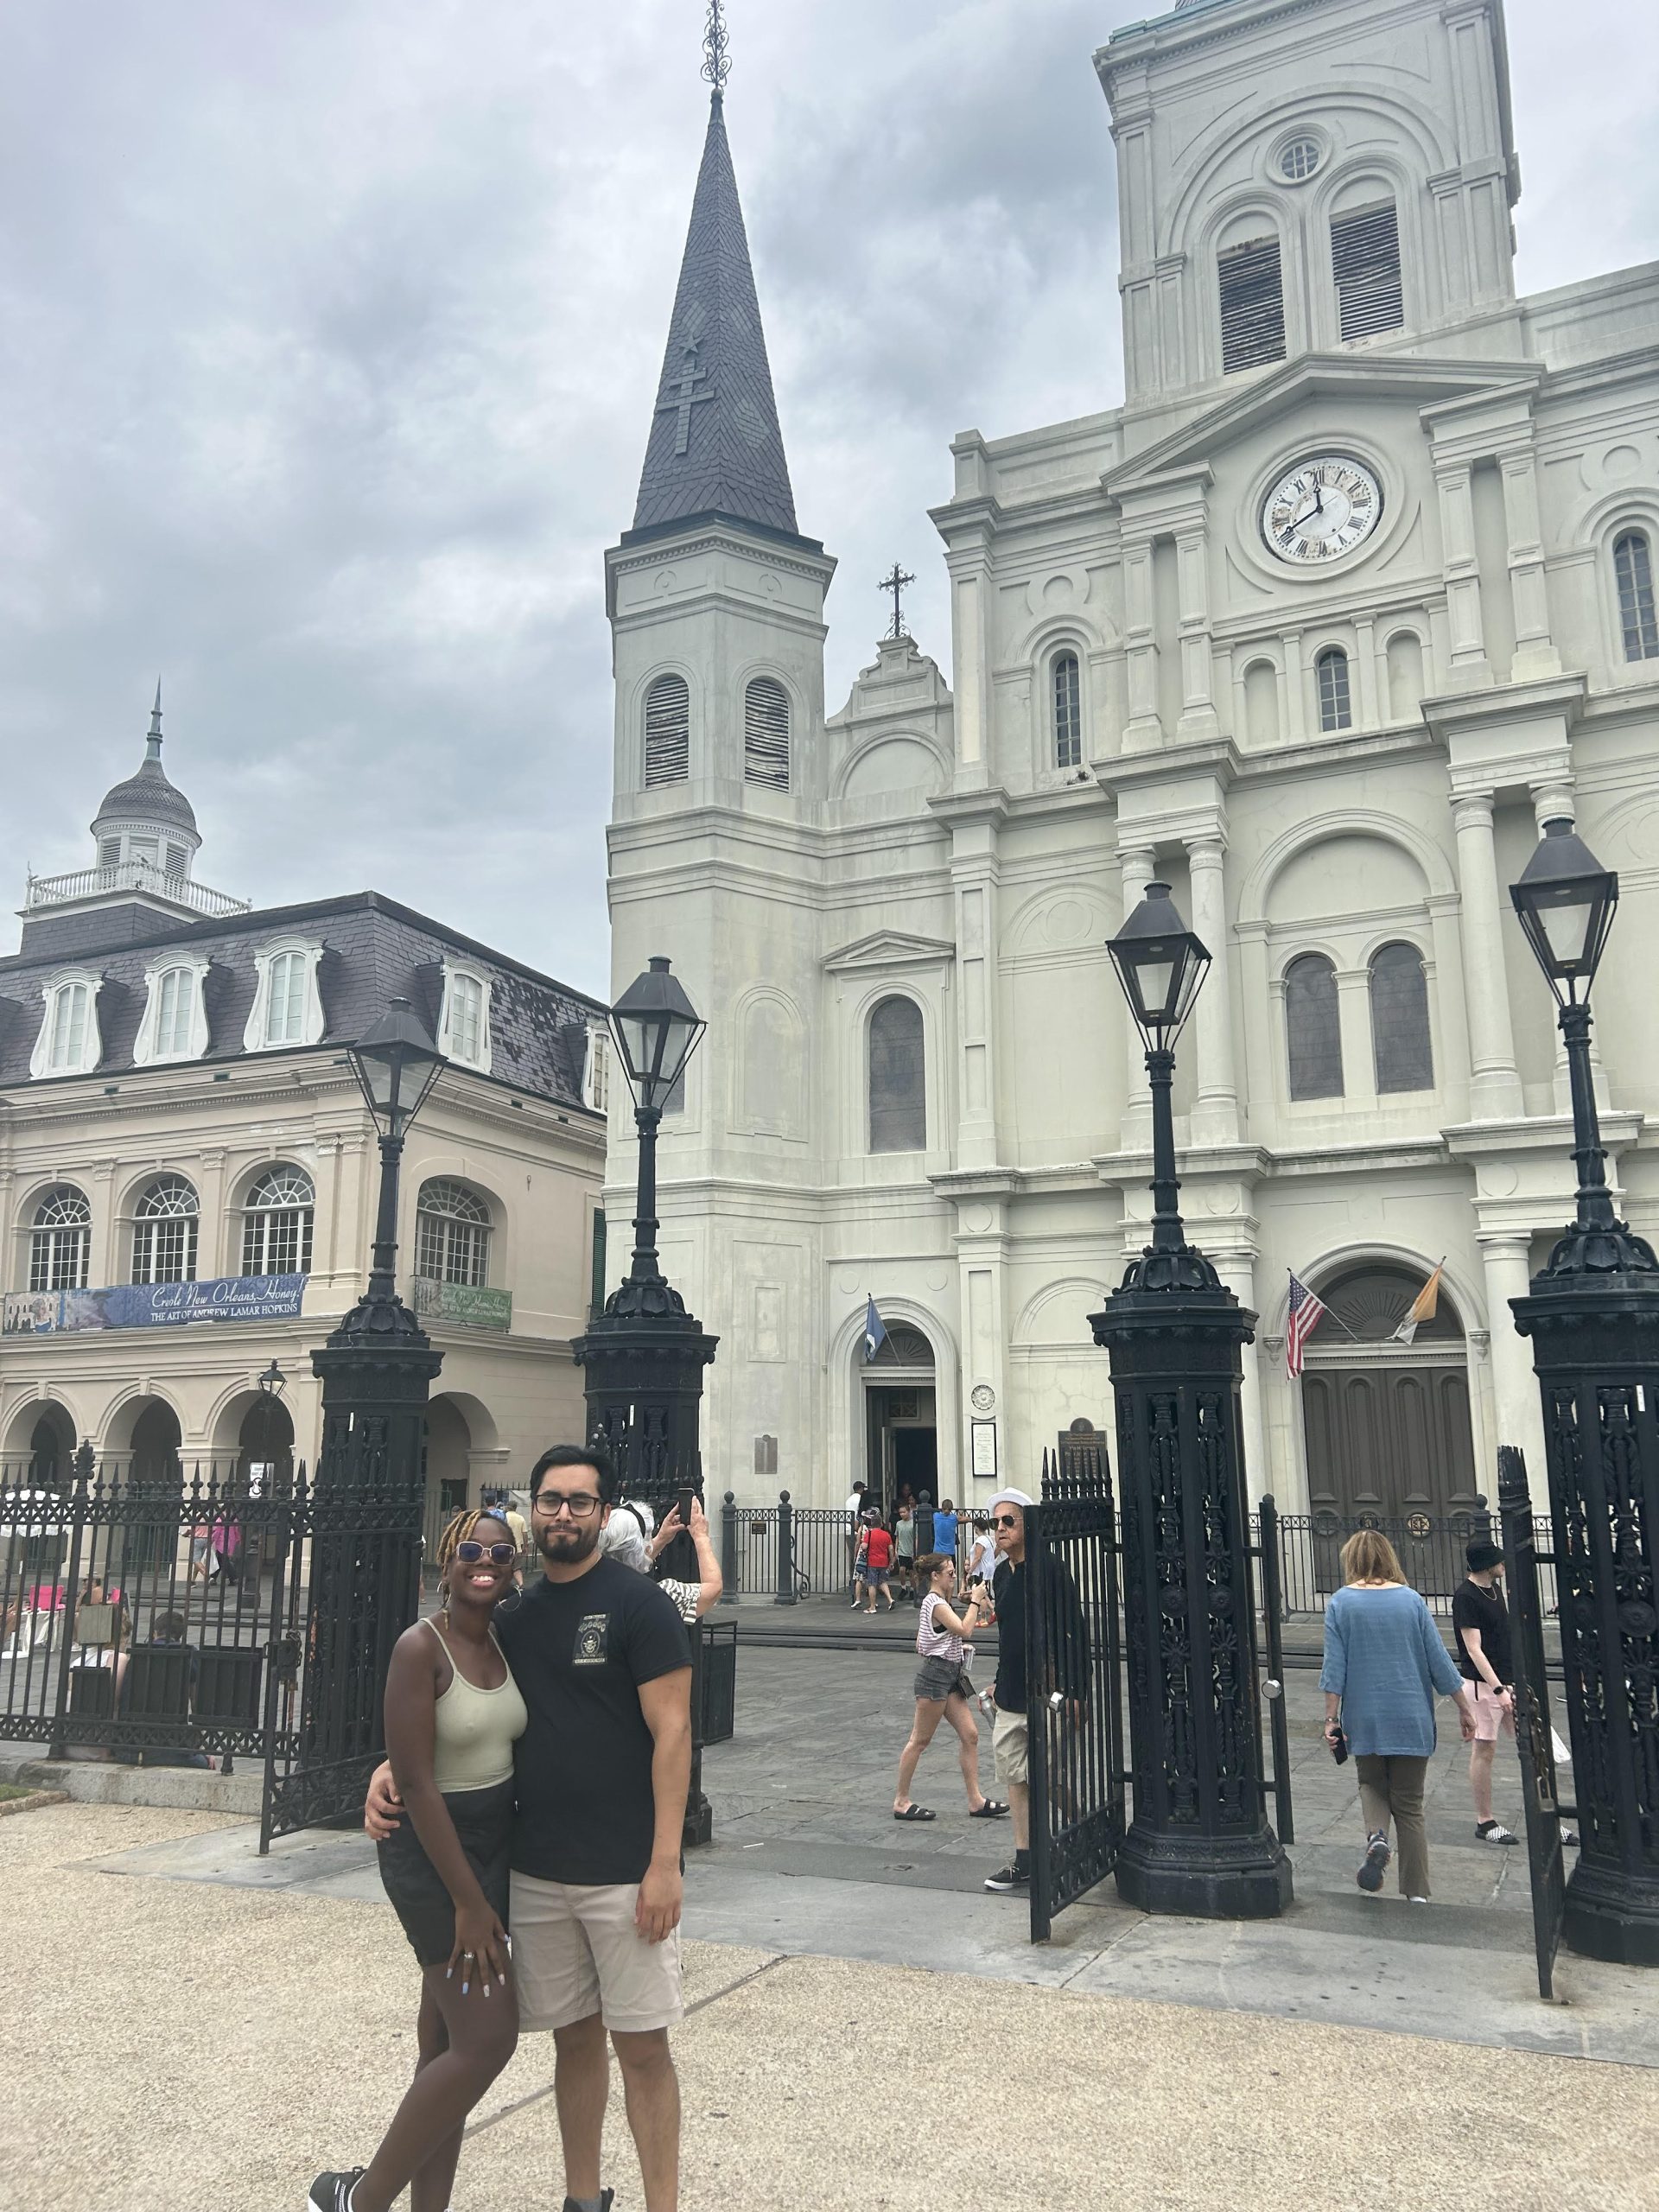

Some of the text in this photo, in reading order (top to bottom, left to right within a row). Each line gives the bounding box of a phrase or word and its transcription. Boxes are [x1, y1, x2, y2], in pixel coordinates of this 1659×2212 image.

[1293, 479, 1306, 494] XI
[1347, 480, 1362, 494] II
[1279, 497, 1294, 507] X
[1352, 498, 1369, 509] III
[152, 1277, 304, 1307] Creole New Orleans, Honey!
[150, 1302, 298, 1322] THE ART OF ANDREW LAMAR HOPKINS
